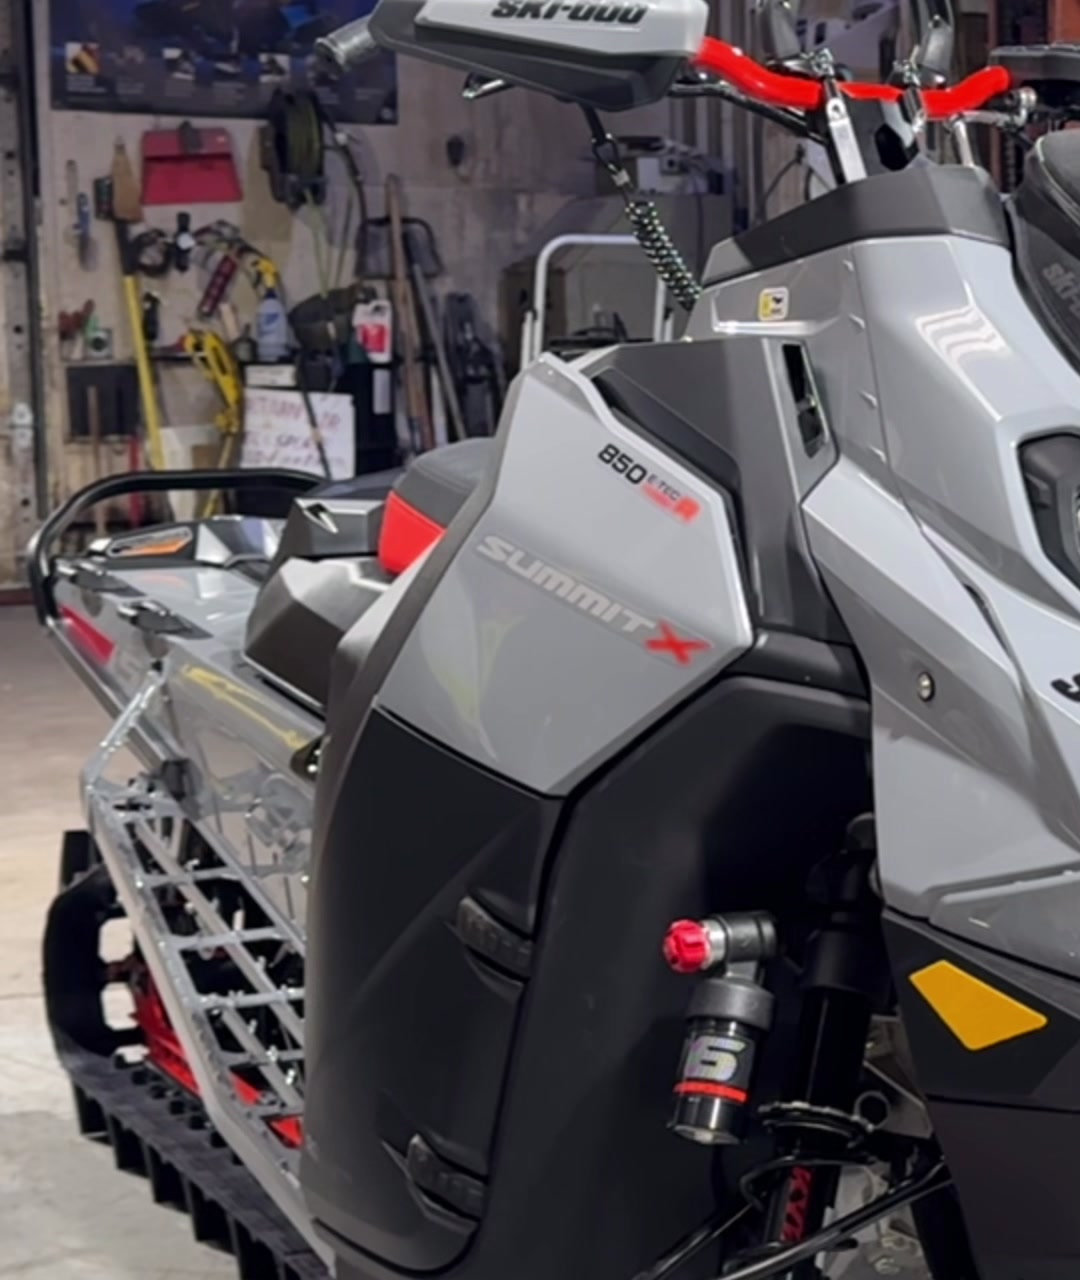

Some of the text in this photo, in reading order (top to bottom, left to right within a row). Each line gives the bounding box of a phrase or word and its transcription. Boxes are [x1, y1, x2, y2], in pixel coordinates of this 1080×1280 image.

[598, 443, 649, 484] 850
[477, 534, 714, 666] SUMMIT X
